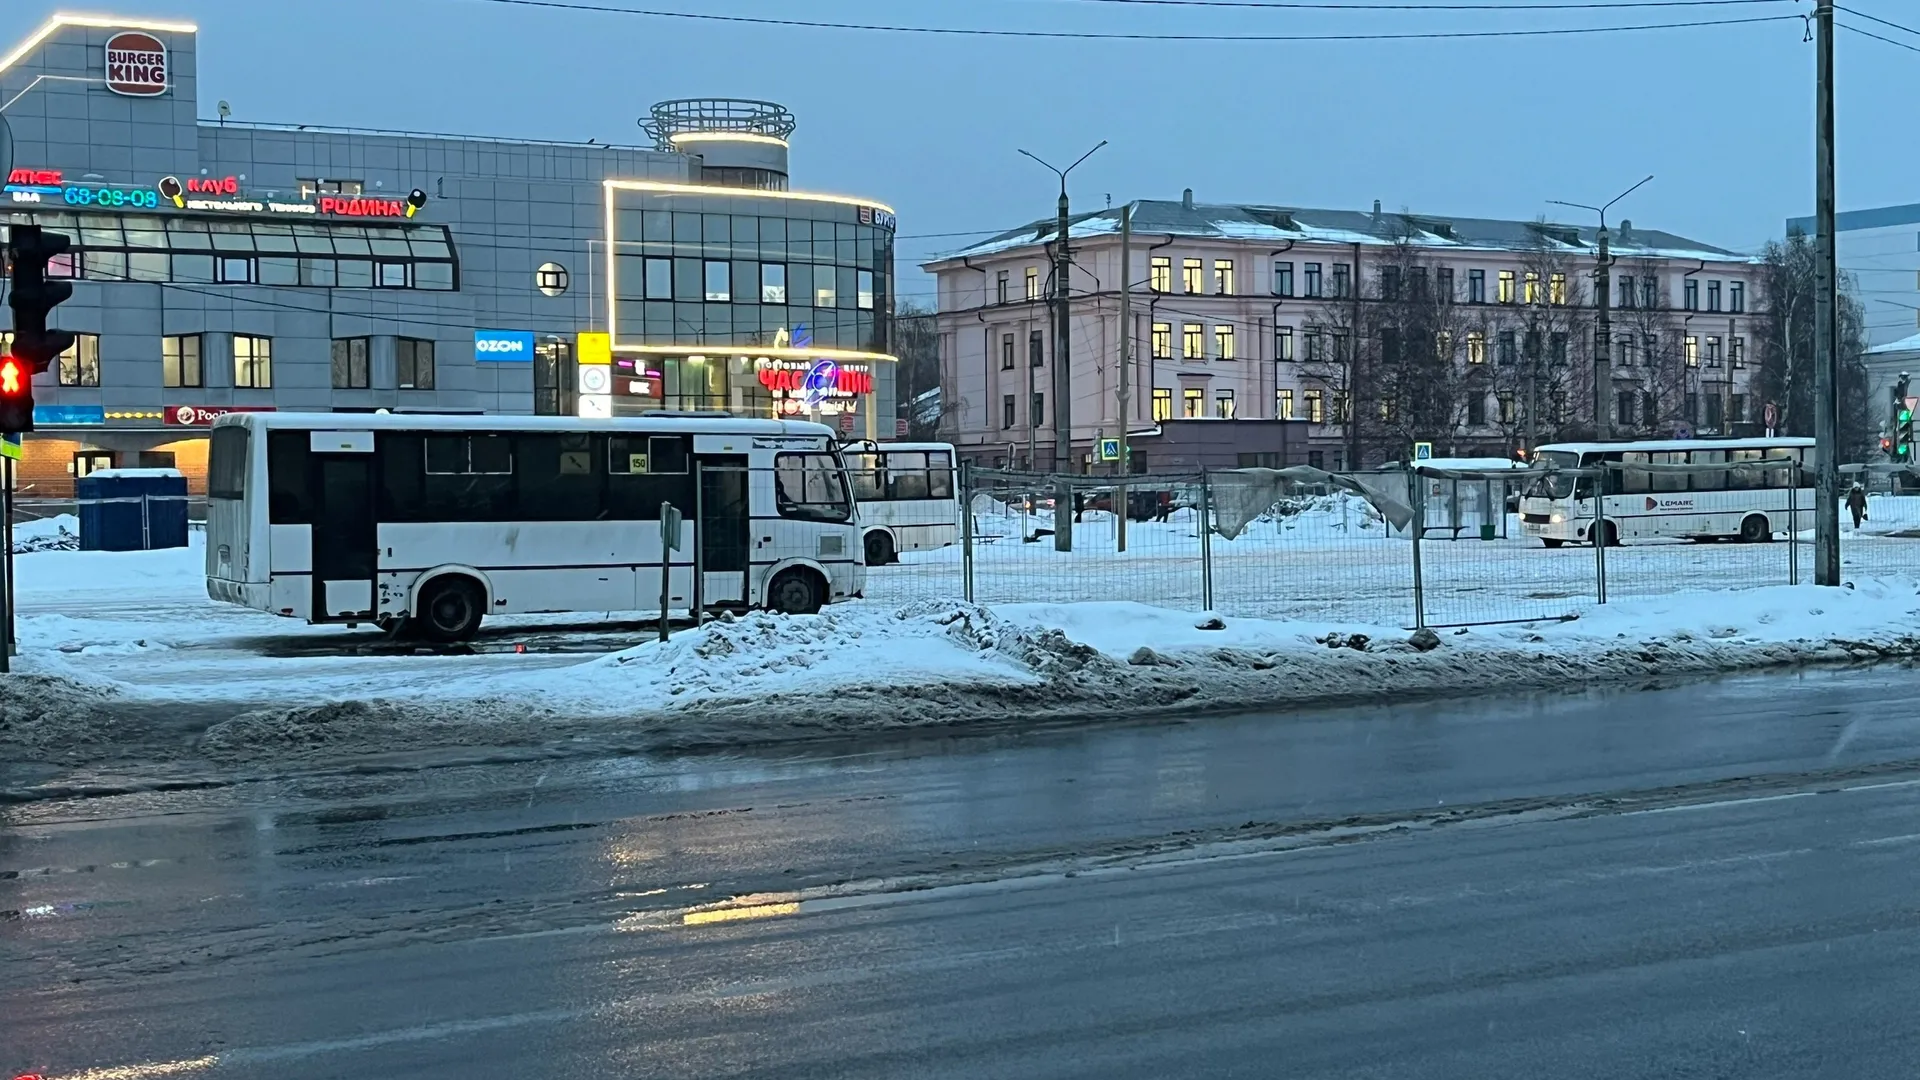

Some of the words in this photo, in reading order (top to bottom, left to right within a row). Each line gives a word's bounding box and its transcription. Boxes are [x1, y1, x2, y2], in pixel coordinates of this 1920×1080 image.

[108, 51, 165, 66] BURGER
[108, 64, 166, 83] KING
[187, 176, 237, 195] Клуб
[476, 339, 523, 352] OZON
[758, 369, 804, 391] ЧАС
[838, 370, 873, 394] ПИК
[632, 458, 646, 468] 150
